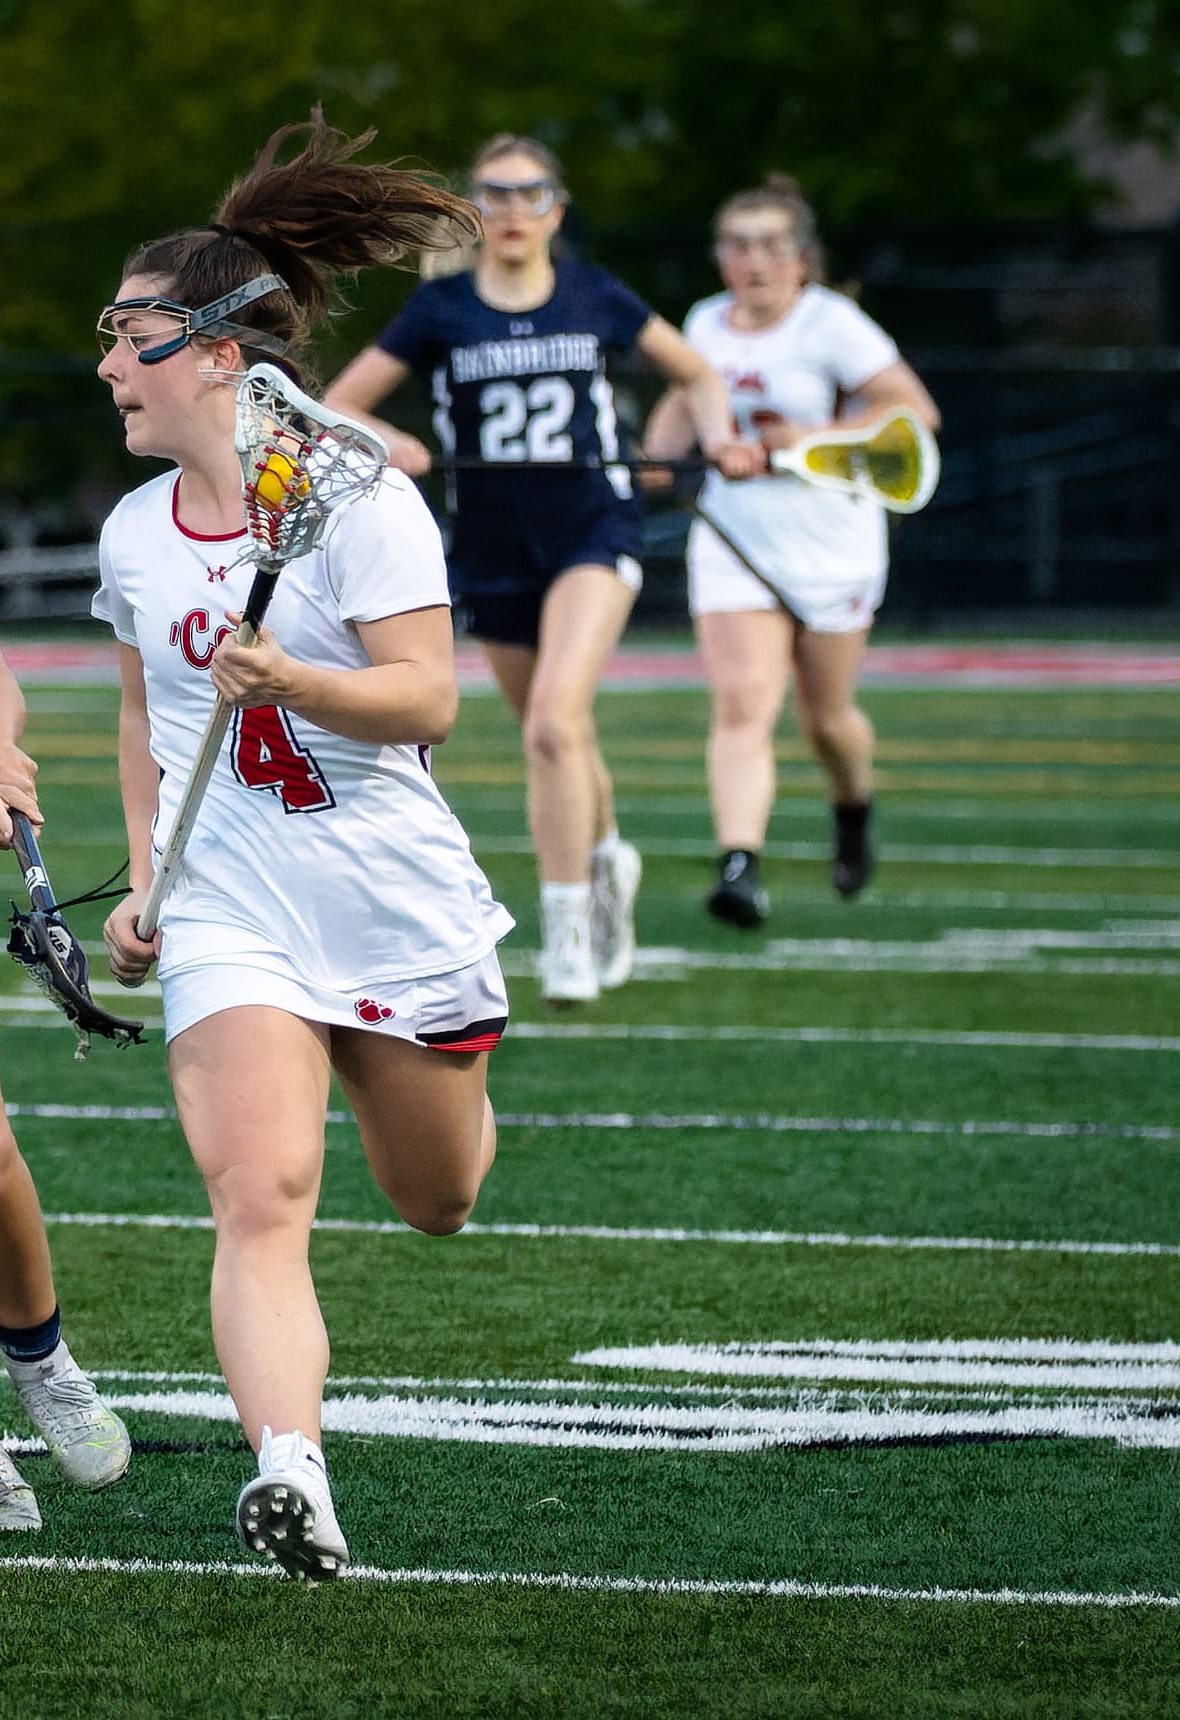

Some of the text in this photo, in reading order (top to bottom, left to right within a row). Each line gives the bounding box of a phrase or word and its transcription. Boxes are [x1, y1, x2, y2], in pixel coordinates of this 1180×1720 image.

[200, 286, 253, 323] STX
[479, 376, 575, 463] 22
[230, 704, 336, 815] 4
